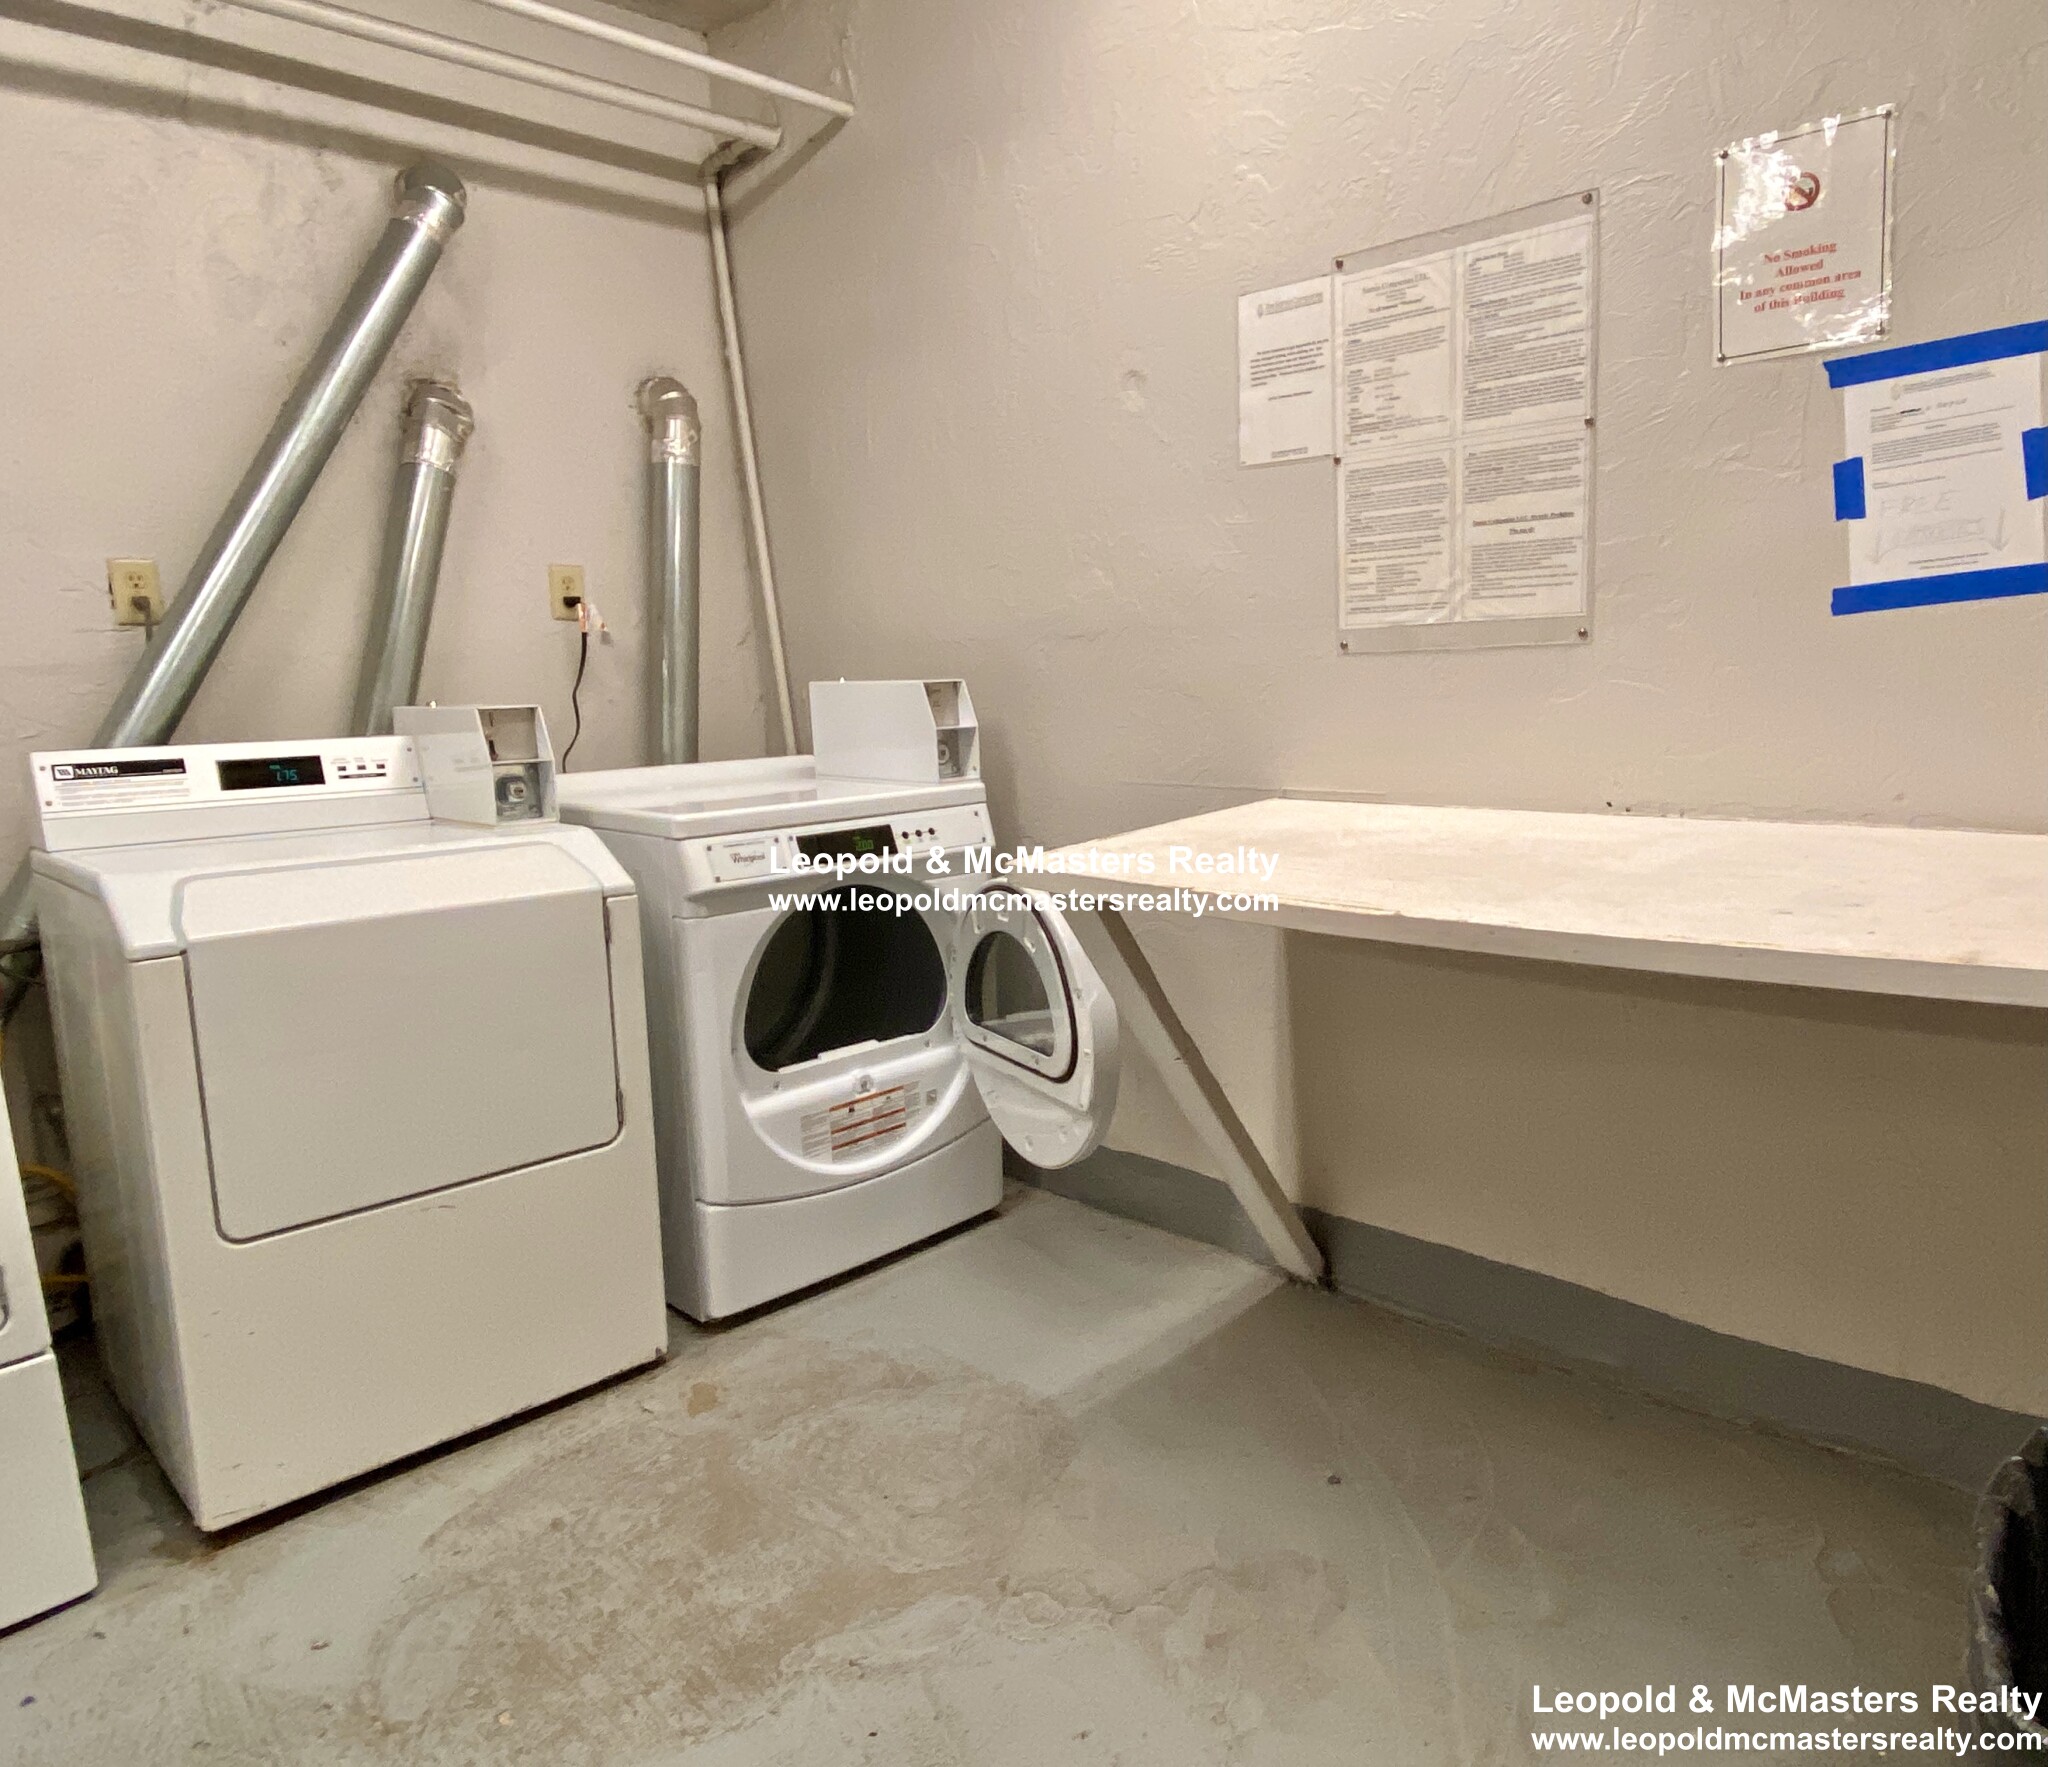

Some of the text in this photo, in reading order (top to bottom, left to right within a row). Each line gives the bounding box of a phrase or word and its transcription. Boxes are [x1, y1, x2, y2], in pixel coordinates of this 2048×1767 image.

[1764, 243, 1837, 263] No Smoking
[1776, 258, 1824, 277] Allowed
[1755, 286, 1775, 298] any
[1780, 275, 1830, 293] common
[1754, 301, 1765, 313] of
[1769, 297, 1790, 309] this
[74, 765, 119, 776] MAYTAG
